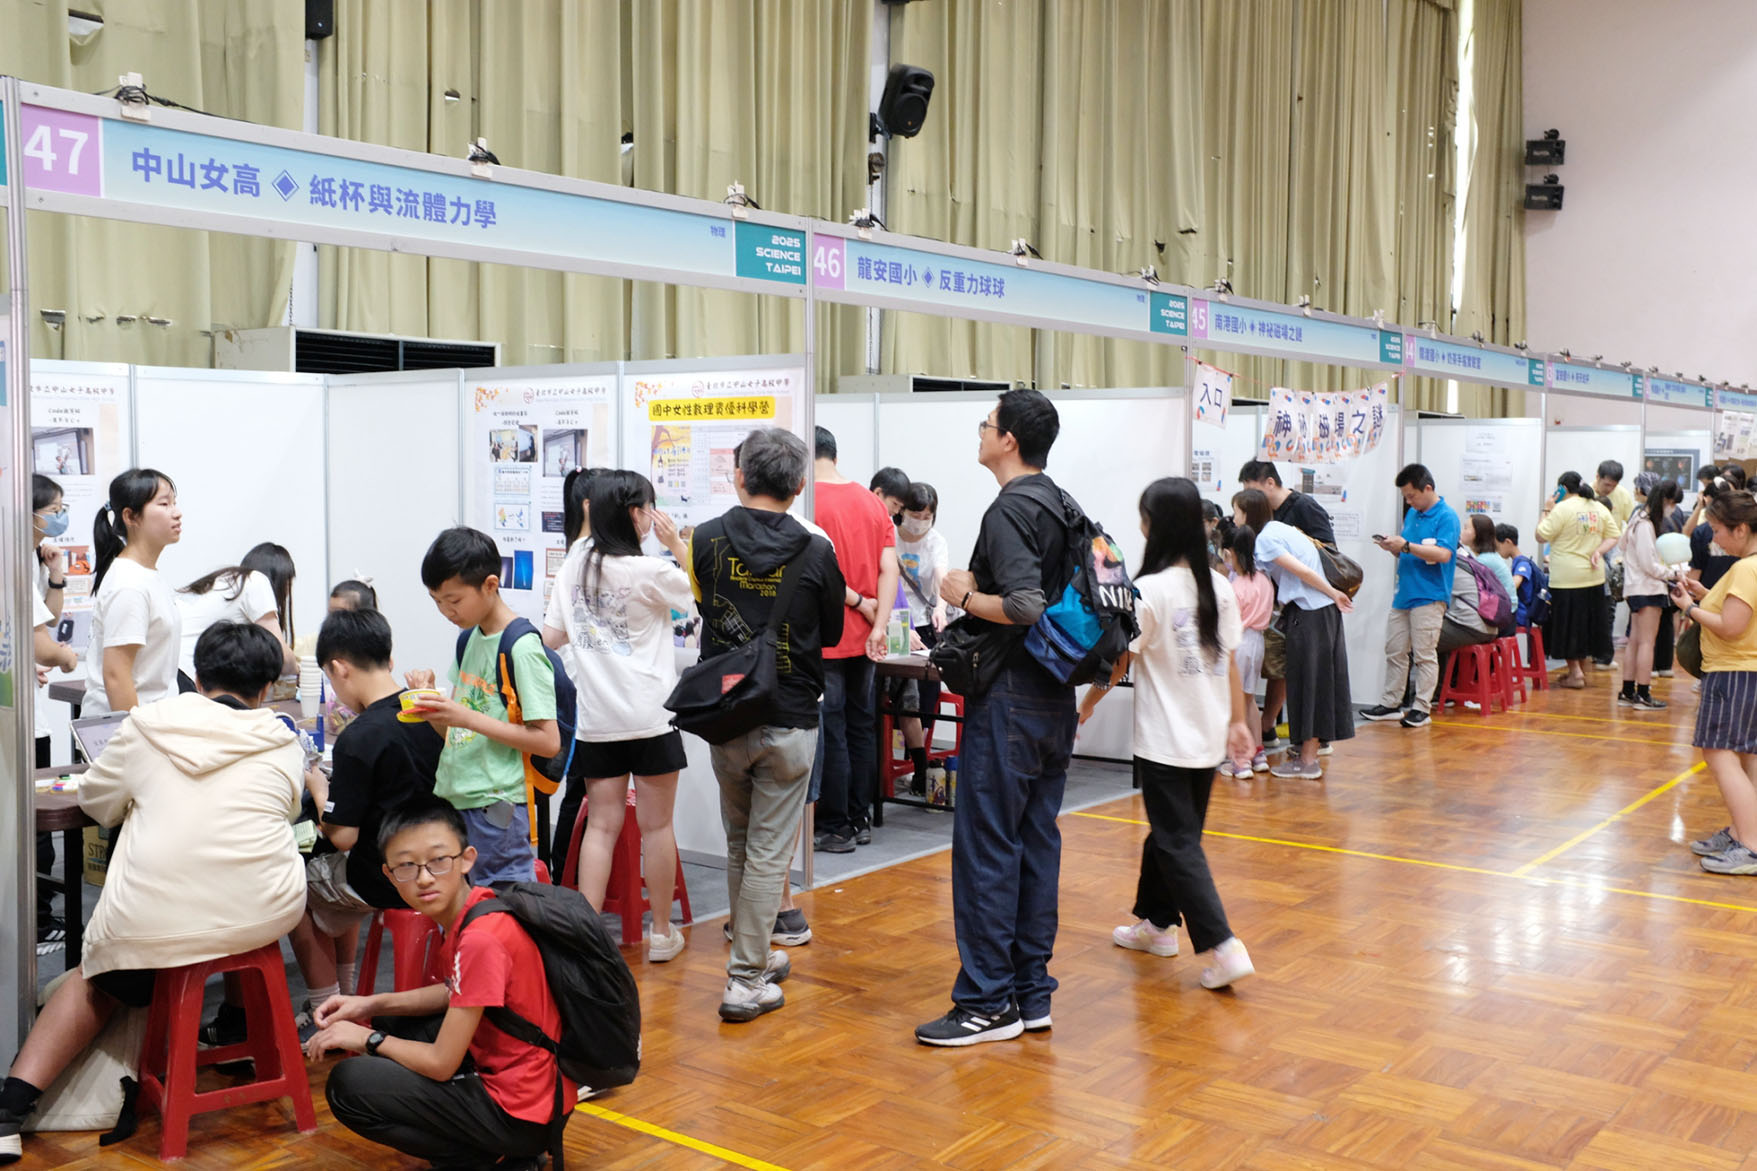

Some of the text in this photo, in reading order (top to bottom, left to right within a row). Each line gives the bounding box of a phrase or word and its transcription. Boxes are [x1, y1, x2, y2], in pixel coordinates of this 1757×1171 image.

[24, 125, 89, 175] 47
[132, 147, 497, 229] 中山女高 紙杯與流體力學
[771, 235, 801, 248] 2025
[755, 247, 801, 262] SCIENCE
[813, 246, 841, 278] 46
[765, 262, 801, 276] TAIPEI
[857, 256, 1006, 298] 龍安國小 反重力球球
[1160, 309, 1185, 320] SCIENCE
[1165, 320, 1185, 330] TAIPEI
[1192, 307, 1206, 330] 45
[1215, 313, 1247, 335] 南港國小
[1200, 382, 1223, 408] 入口
[652, 400, 770, 417] 國中女性數理資優科學營
